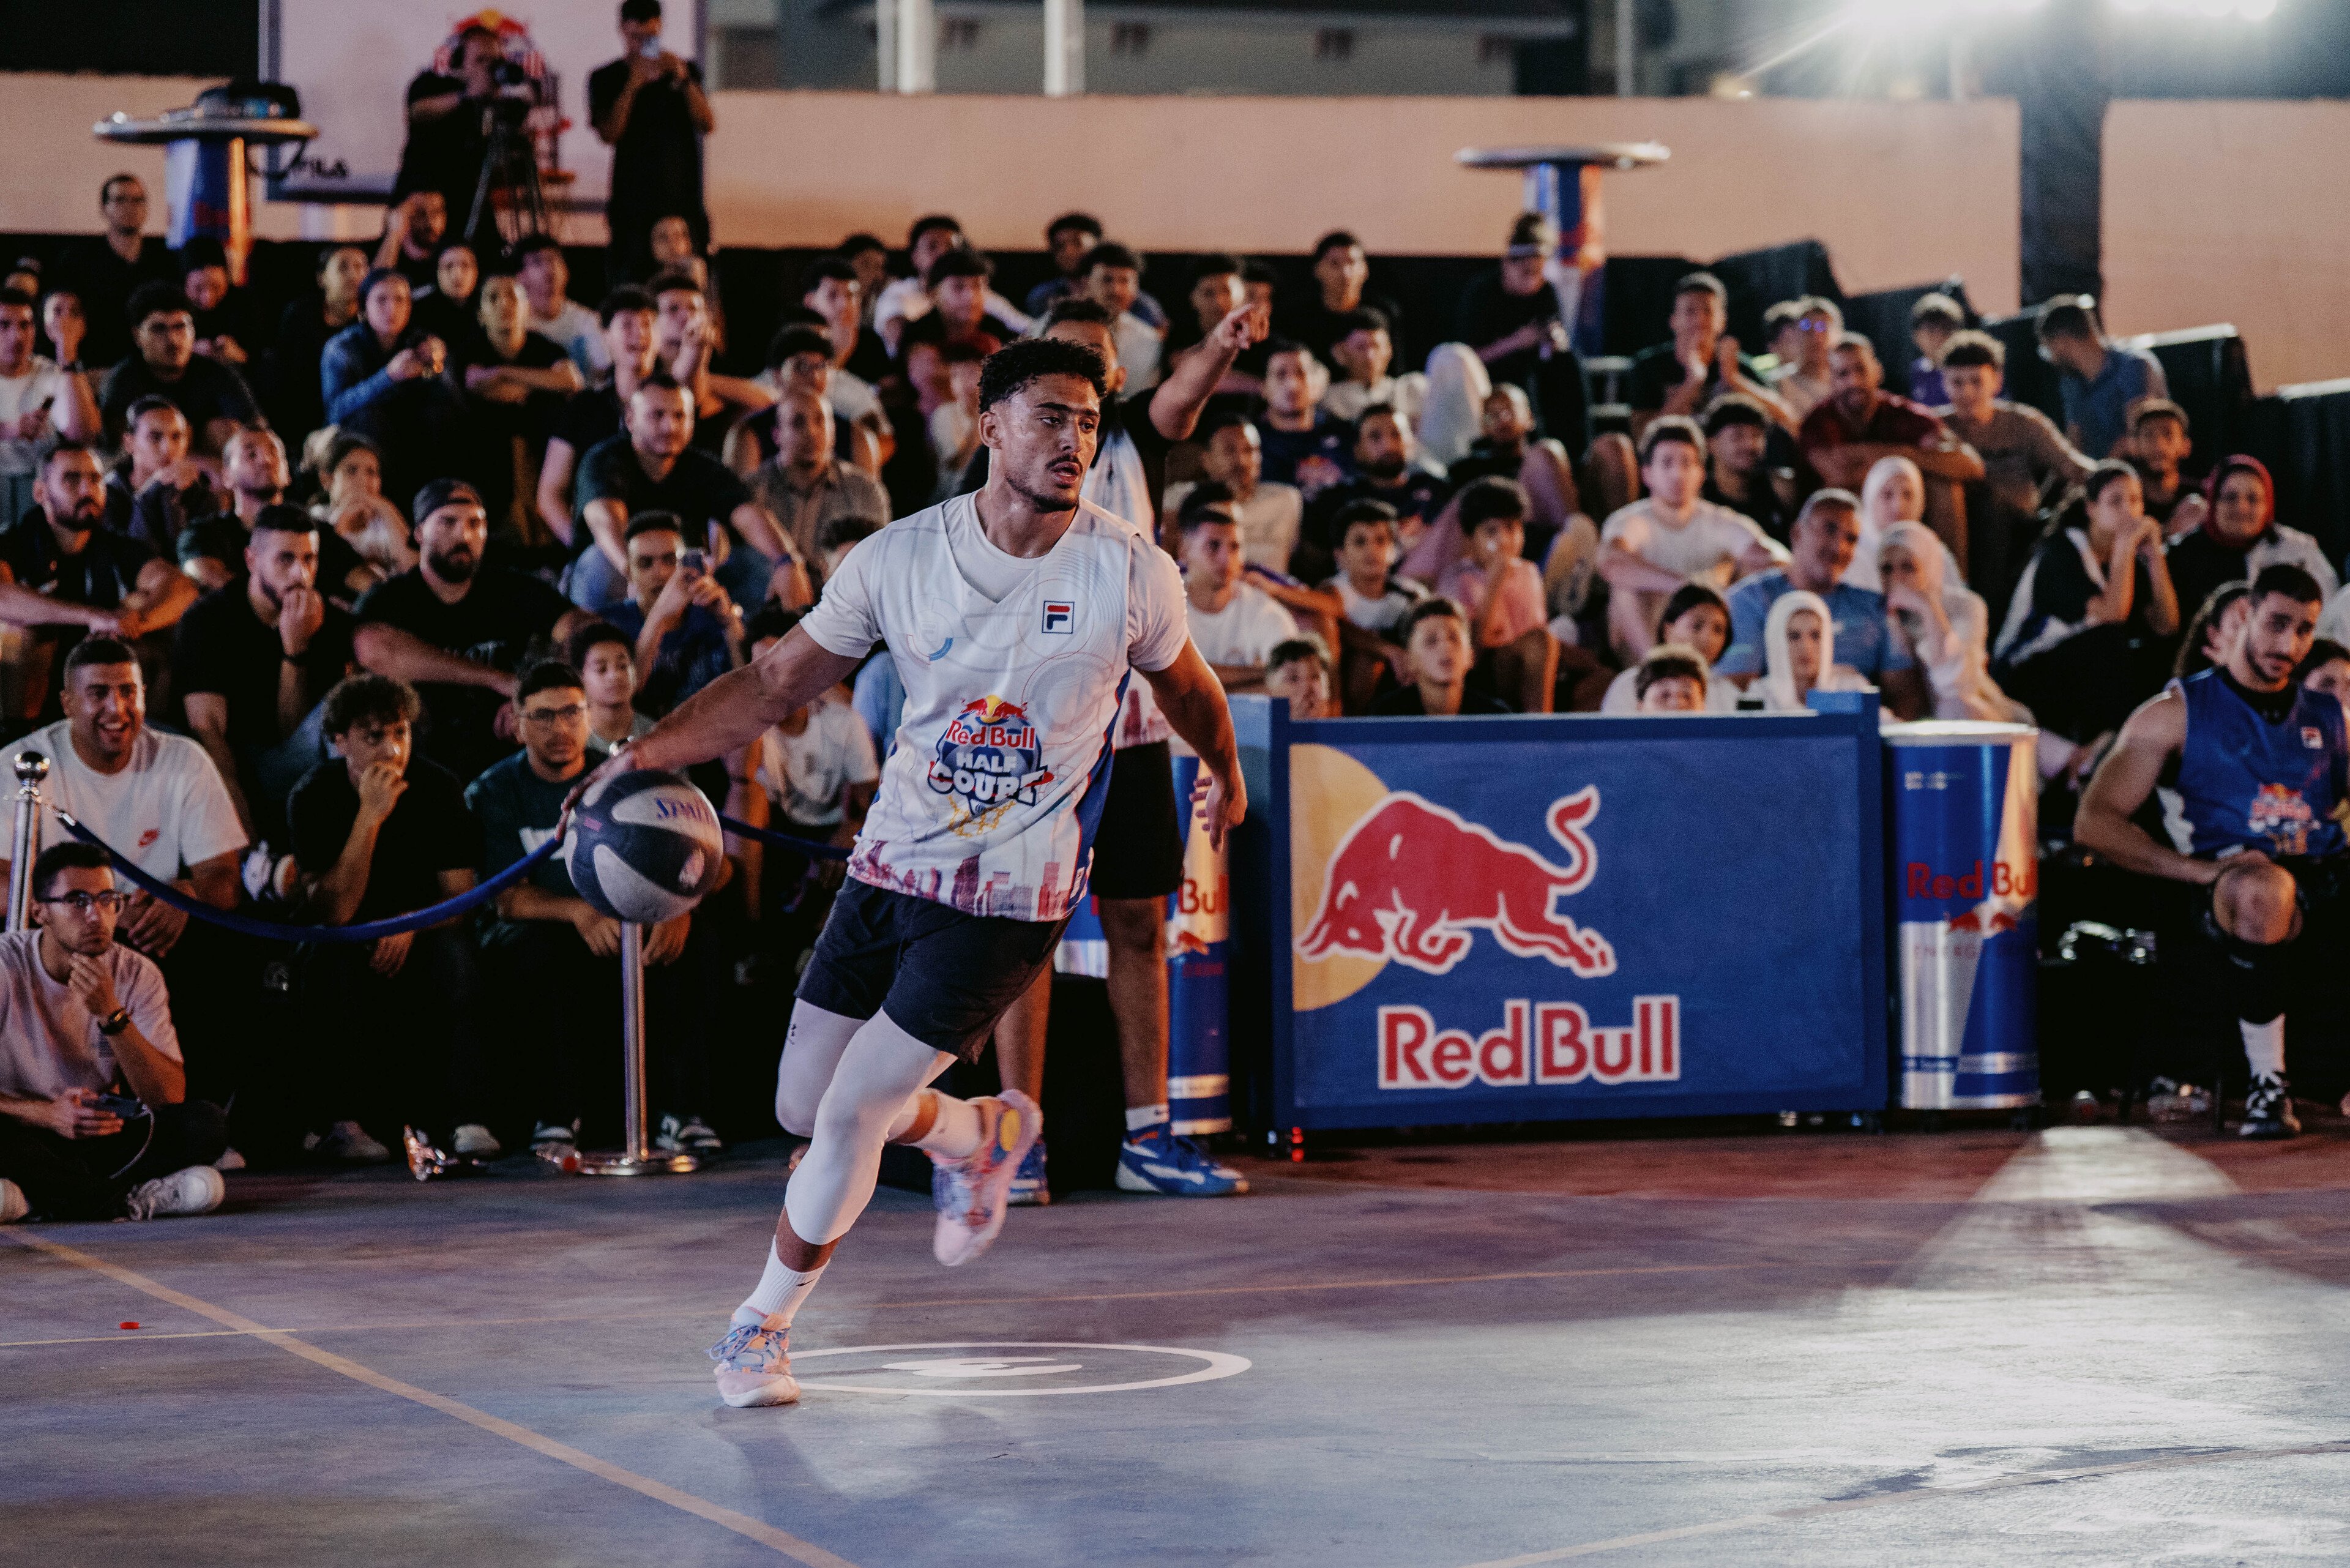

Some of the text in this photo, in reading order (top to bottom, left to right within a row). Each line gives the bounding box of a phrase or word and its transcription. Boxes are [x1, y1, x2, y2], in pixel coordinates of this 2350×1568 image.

[946, 720, 1036, 749] Red Bull
[955, 751, 1018, 774] HALF
[1907, 860, 1983, 898] Red
[1383, 1000, 1675, 1083] Red Bull
